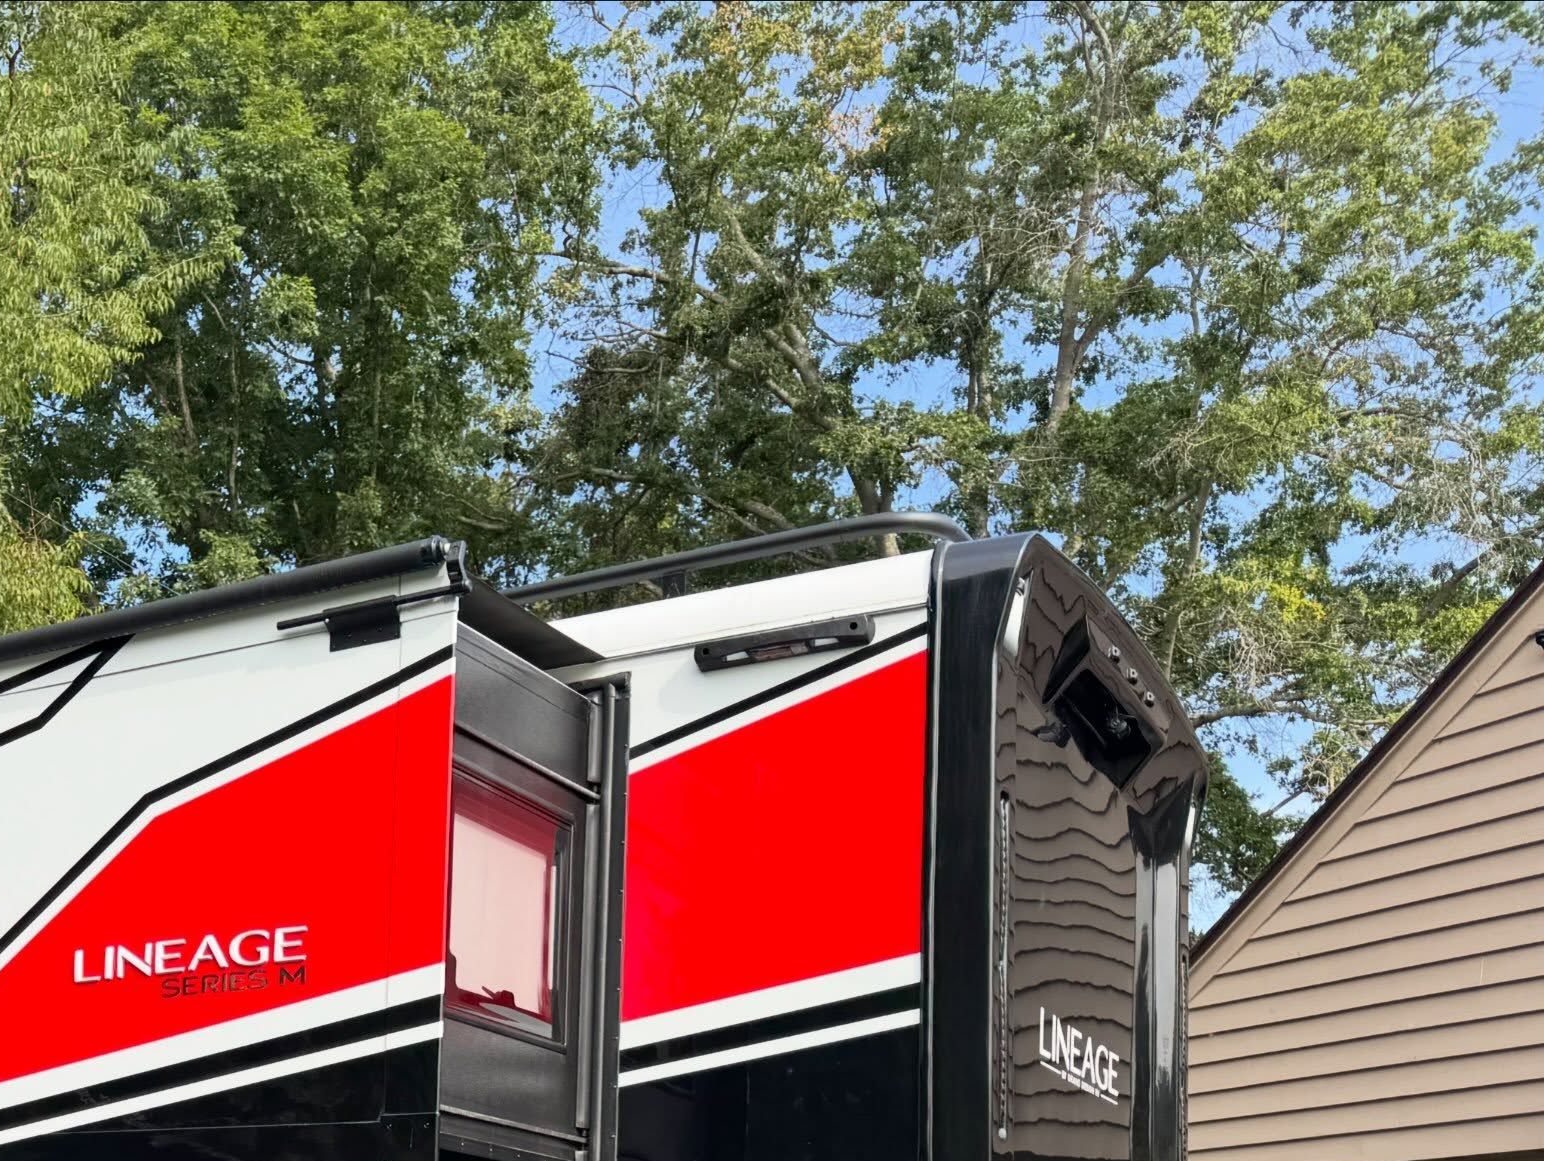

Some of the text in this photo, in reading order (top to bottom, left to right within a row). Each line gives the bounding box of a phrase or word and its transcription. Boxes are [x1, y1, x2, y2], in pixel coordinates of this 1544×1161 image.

[73, 925, 309, 984] LINEAGE
[161, 965, 306, 999] SERIES M
[1039, 1006, 1120, 1097] LINEAGE
